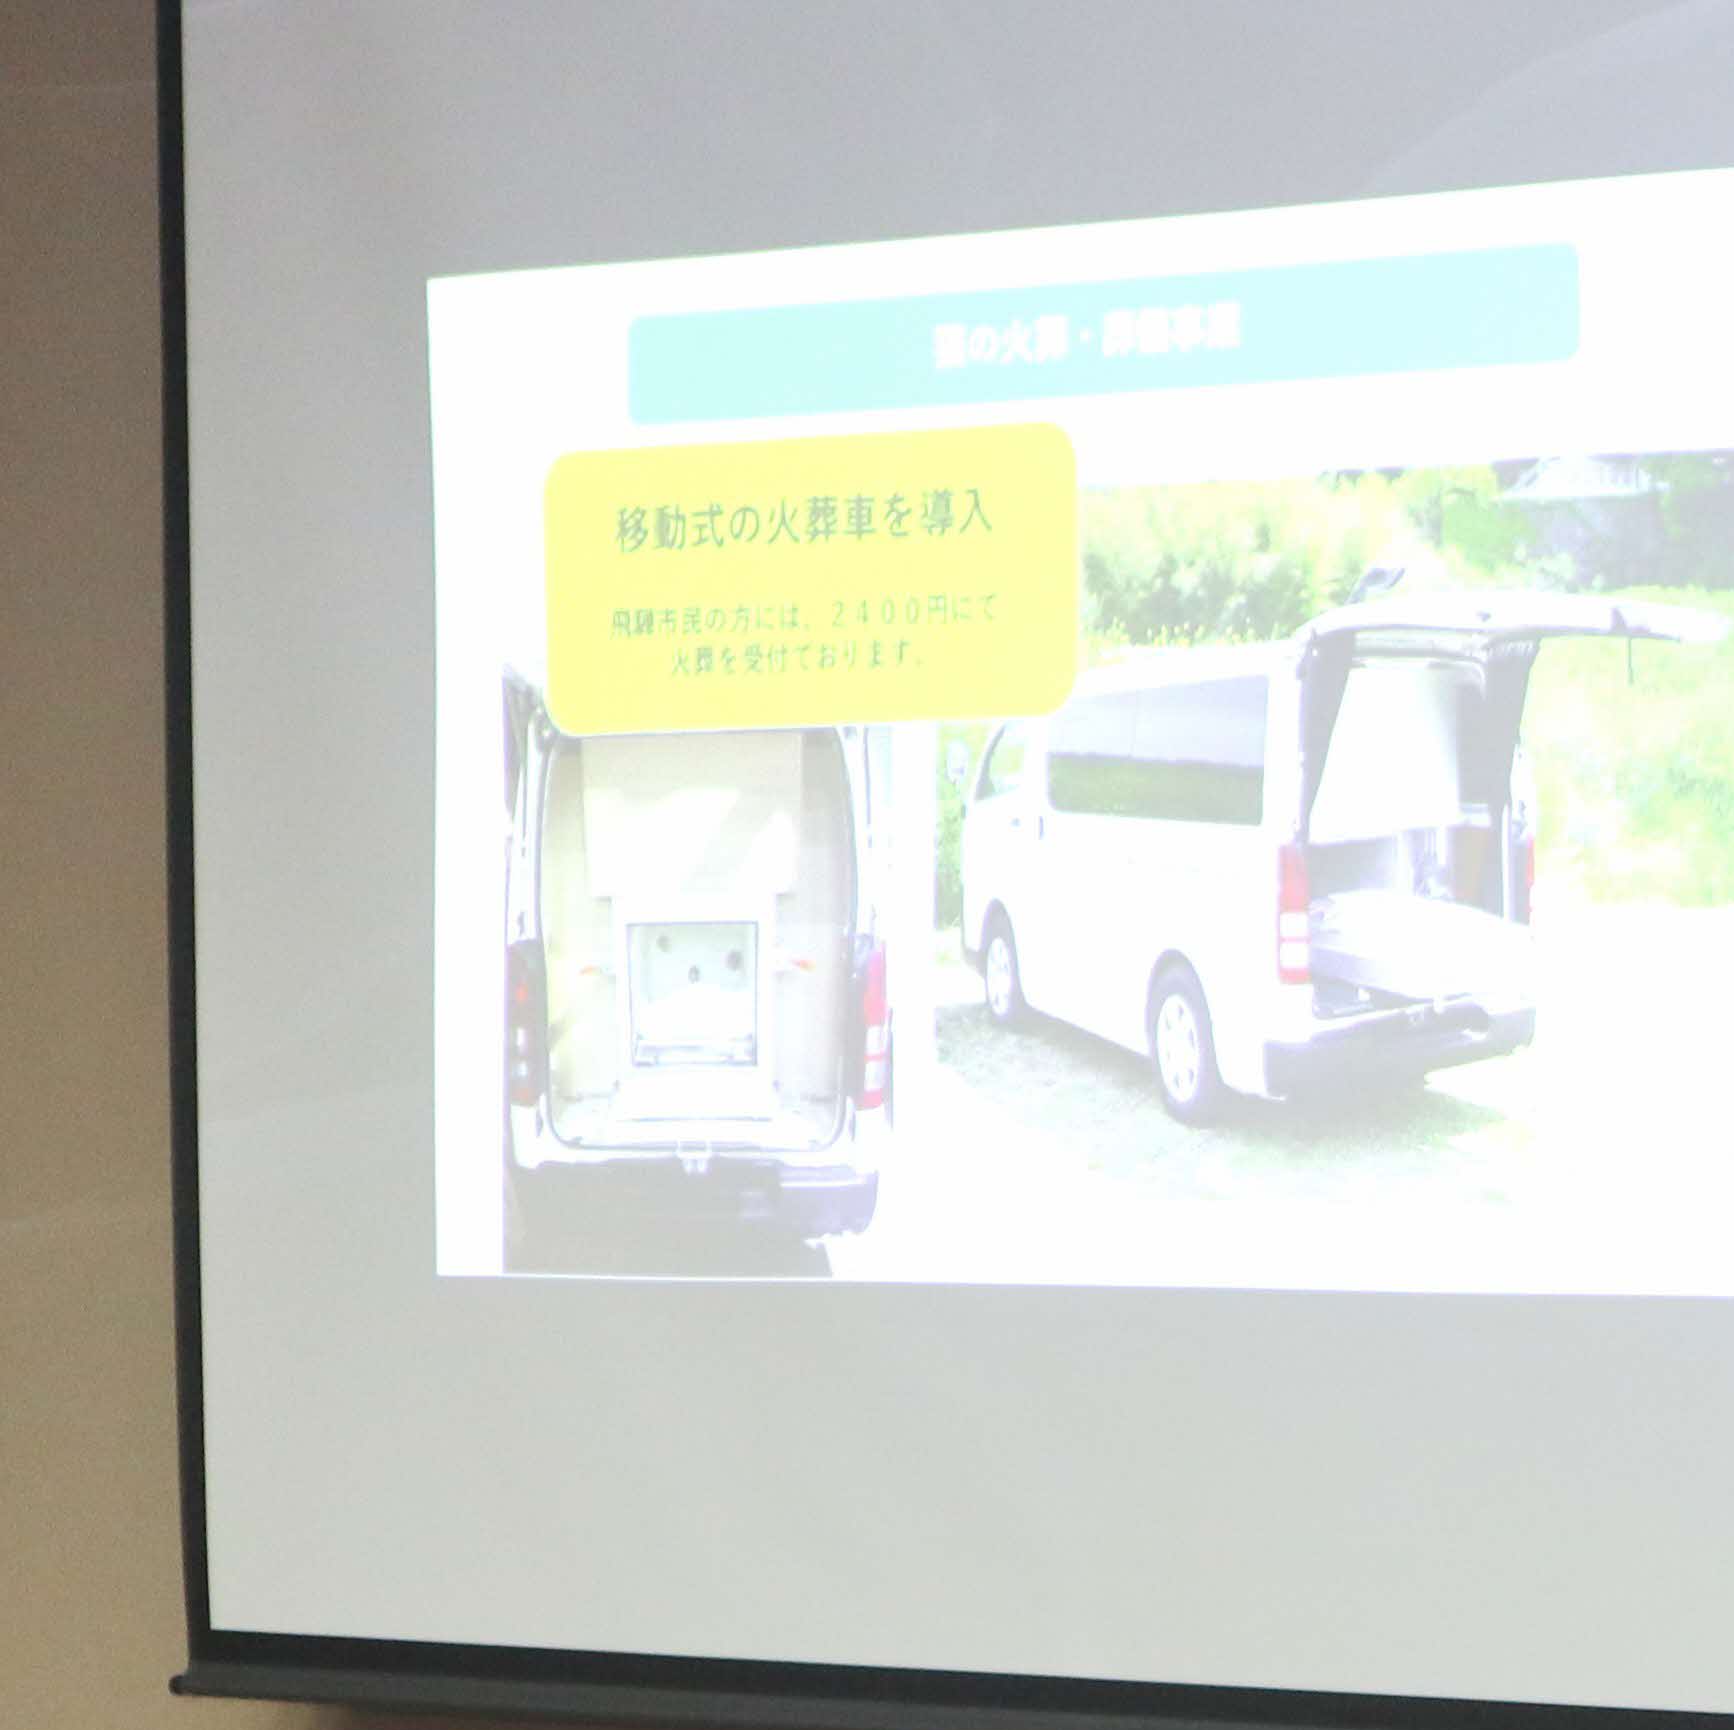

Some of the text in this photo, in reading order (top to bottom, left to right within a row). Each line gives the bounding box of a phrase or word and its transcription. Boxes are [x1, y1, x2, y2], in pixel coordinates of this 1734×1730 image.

[615, 490, 993, 552] 移動式の火葬車を導入
